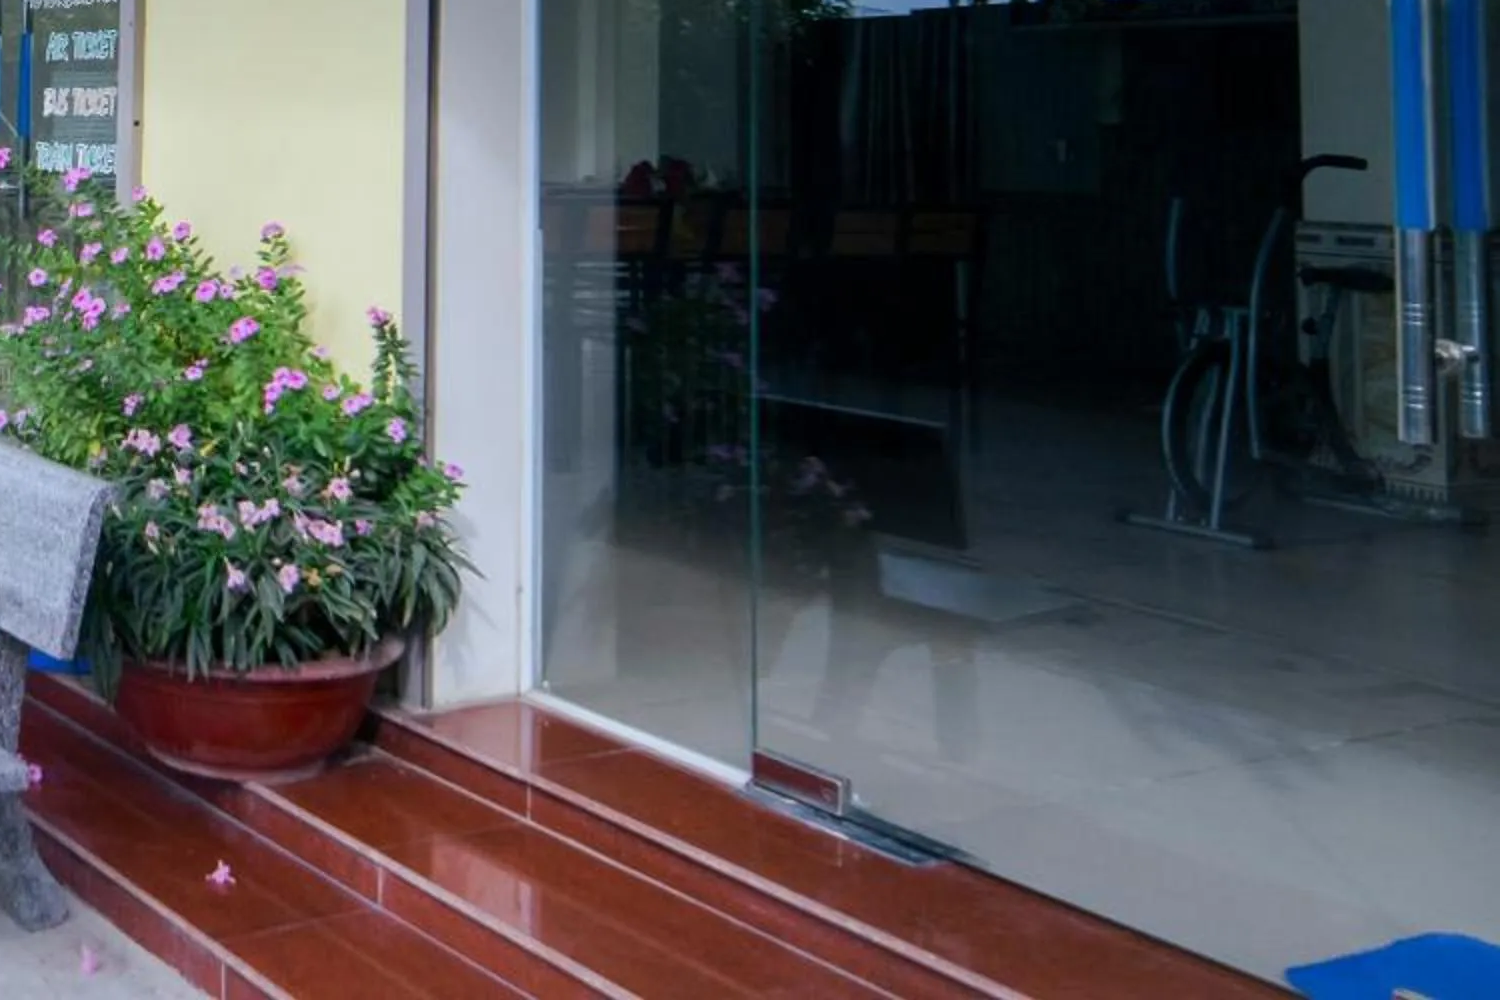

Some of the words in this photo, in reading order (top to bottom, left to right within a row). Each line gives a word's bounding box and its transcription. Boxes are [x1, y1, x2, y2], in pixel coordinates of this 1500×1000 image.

[72, 29, 117, 60] TICKET
[71, 87, 117, 117] TICKET
[76, 143, 116, 174] TICKE
